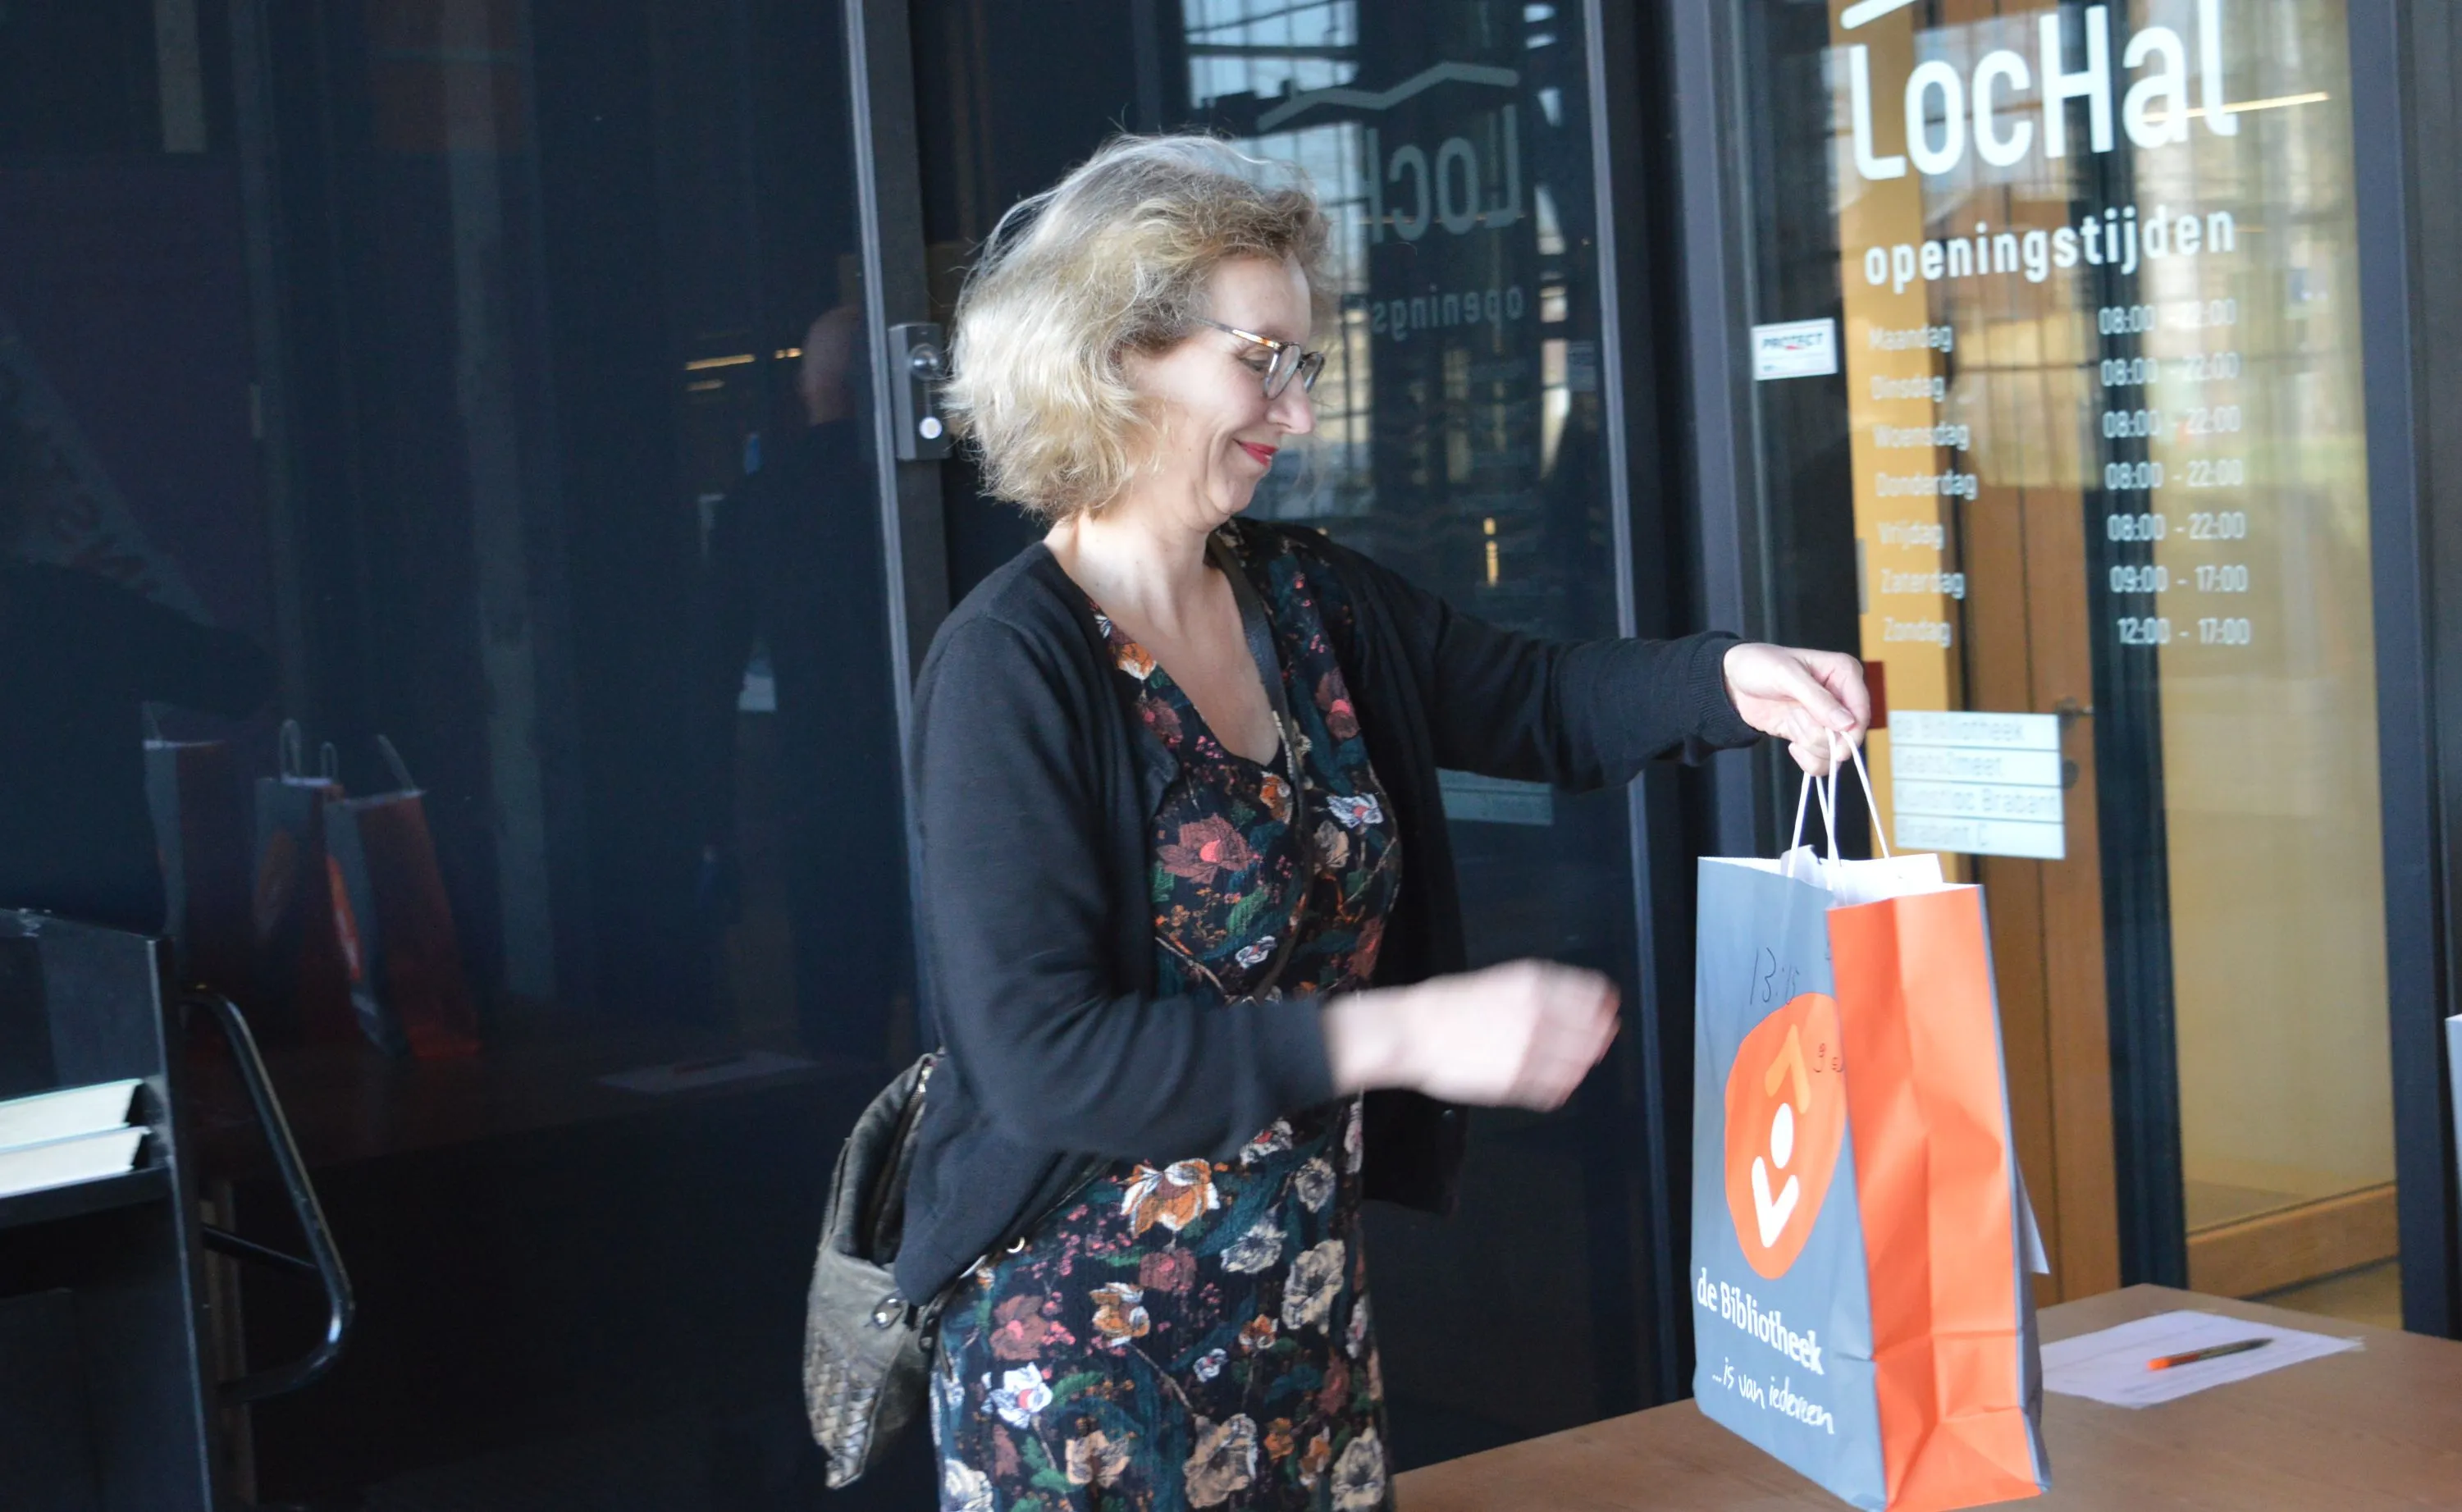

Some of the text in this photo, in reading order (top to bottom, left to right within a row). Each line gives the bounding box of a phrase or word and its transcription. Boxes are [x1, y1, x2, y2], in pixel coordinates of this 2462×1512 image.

[1849, 0, 2238, 180] LocHal
[1865, 205, 2236, 293] openingstijden
[1869, 323, 1952, 352] Maandag
[2099, 304, 2155, 335] 08:00
[1871, 374, 1944, 402] Dinsdag
[2101, 358, 2158, 386] 08:00
[1873, 422, 1970, 450] Woensdag
[2103, 408, 2162, 438] 08:00
[2186, 405, 2241, 435] 22:00
[2105, 461, 2164, 490] 08:00
[2186, 459, 2243, 487] 22:00
[1878, 518, 1944, 550] Vrijdag
[2108, 513, 2167, 541] 08:00
[2188, 511, 2245, 540] 22:00
[1880, 567, 1965, 599] Zaterdag
[2109, 564, 2168, 592] 09:00
[2195, 564, 2248, 592] 17:00
[1884, 616, 1950, 647] Zondag
[2117, 617, 2171, 645] 12:00
[2198, 618, 2250, 645] 17:00
[1697, 1267, 1825, 1376] de Bibliotheek
[1738, 1373, 1765, 1409] van
[1769, 1376, 1834, 1435] iedereen
